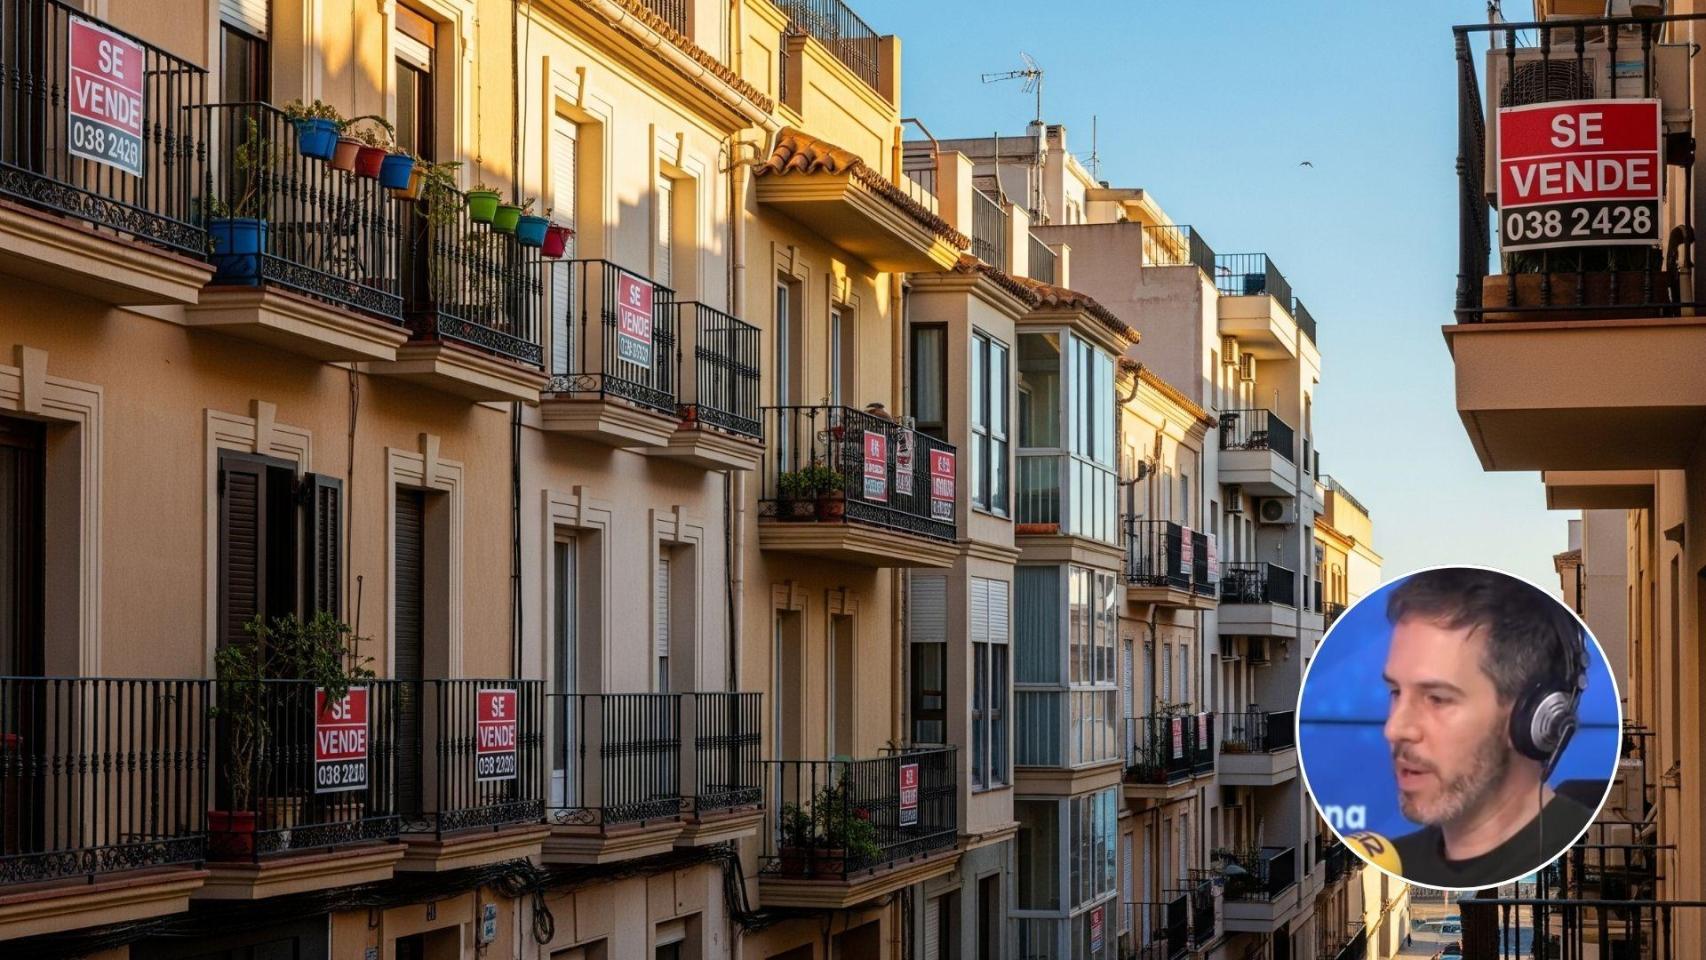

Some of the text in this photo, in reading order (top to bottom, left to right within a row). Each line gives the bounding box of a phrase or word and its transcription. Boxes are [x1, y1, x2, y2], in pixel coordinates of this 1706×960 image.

[98, 39, 124, 79] SE
[74, 75, 140, 130] VENDE
[73, 121, 105, 153] 038
[1551, 112, 1604, 148] SE
[1509, 158, 1651, 197] VENDE
[1506, 206, 1651, 241] 038 2428
[331, 695, 352, 720] SE
[491, 695, 505, 718] SE
[318, 729, 366, 755] VENDE
[480, 725, 514, 748] VENDE
[318, 764, 341, 785] 038
